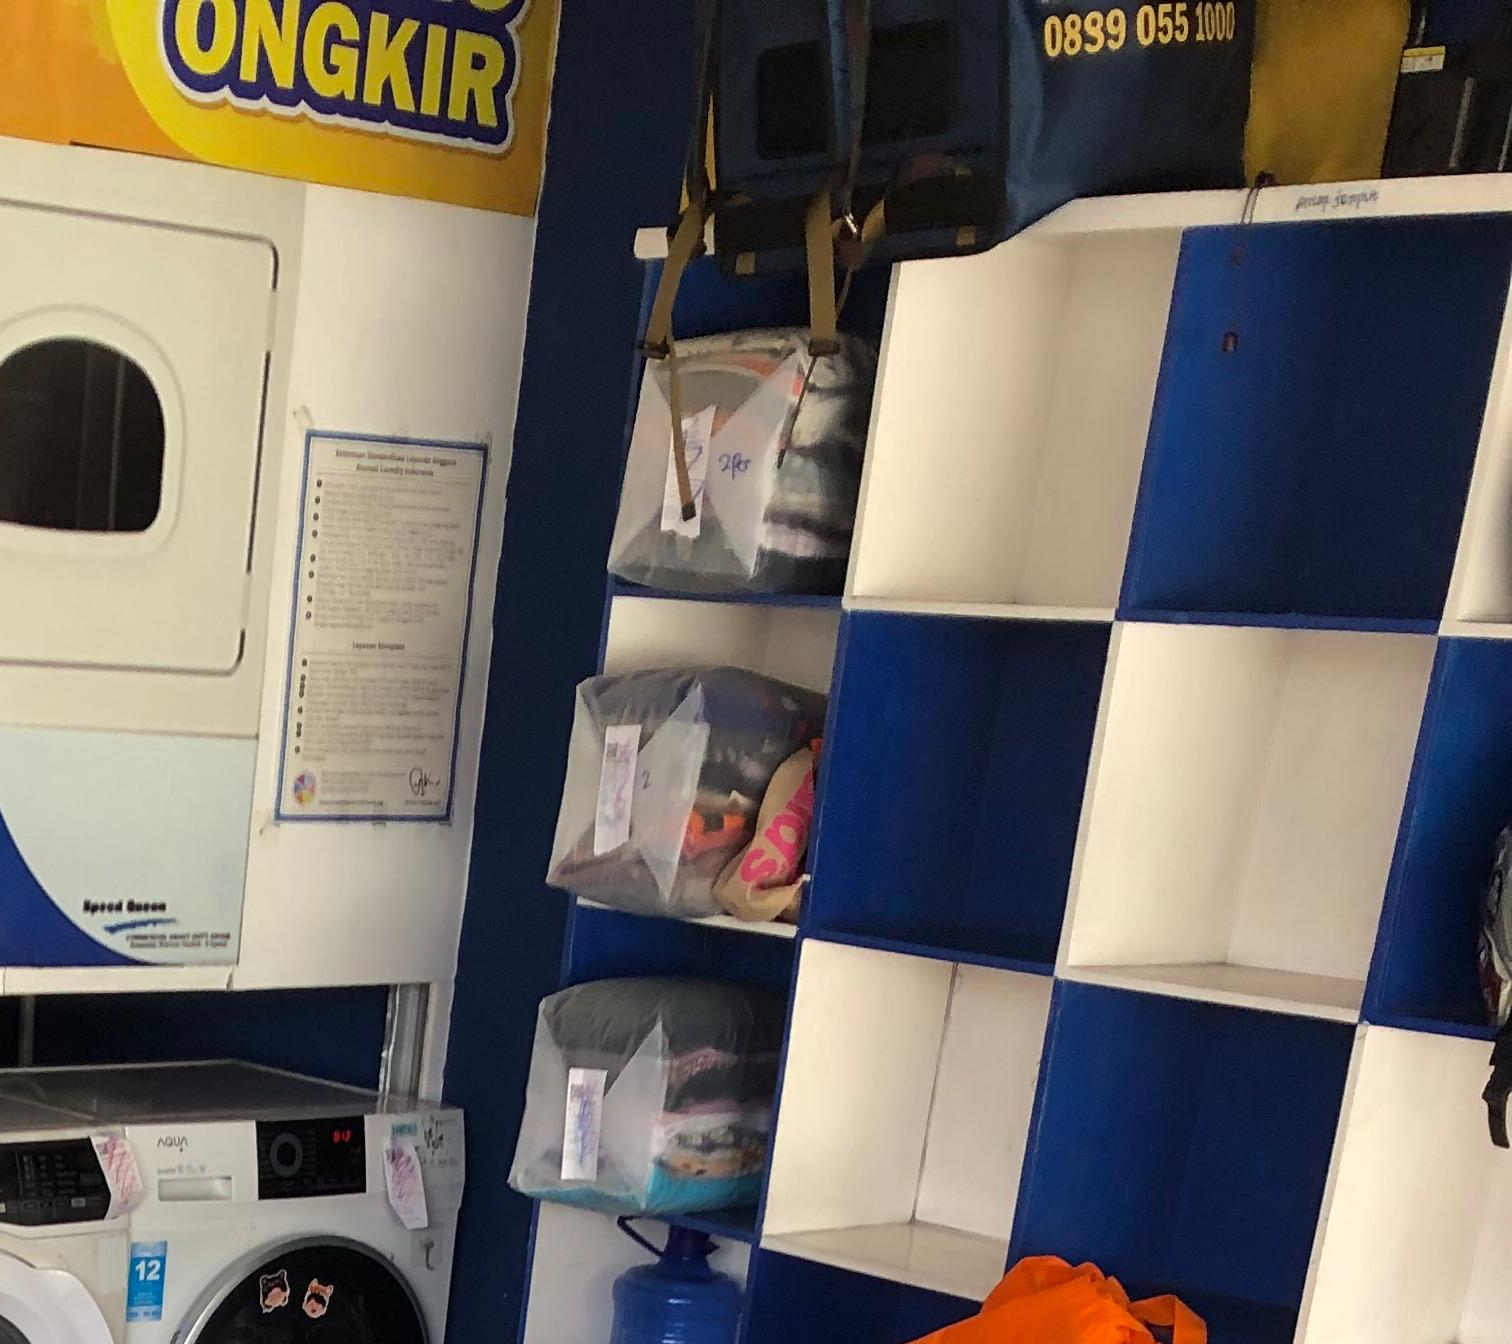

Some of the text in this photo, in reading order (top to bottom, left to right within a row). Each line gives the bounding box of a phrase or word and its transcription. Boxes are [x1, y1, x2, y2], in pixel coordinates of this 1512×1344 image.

[1137, 2, 1189, 46] 055
[1195, 1, 1236, 41] 1000
[174, 0, 506, 128] ONGKIR
[83, 900, 167, 916] Speed Queen
[157, 1136, 189, 1149] AQUA
[135, 1259, 161, 1281] 12
